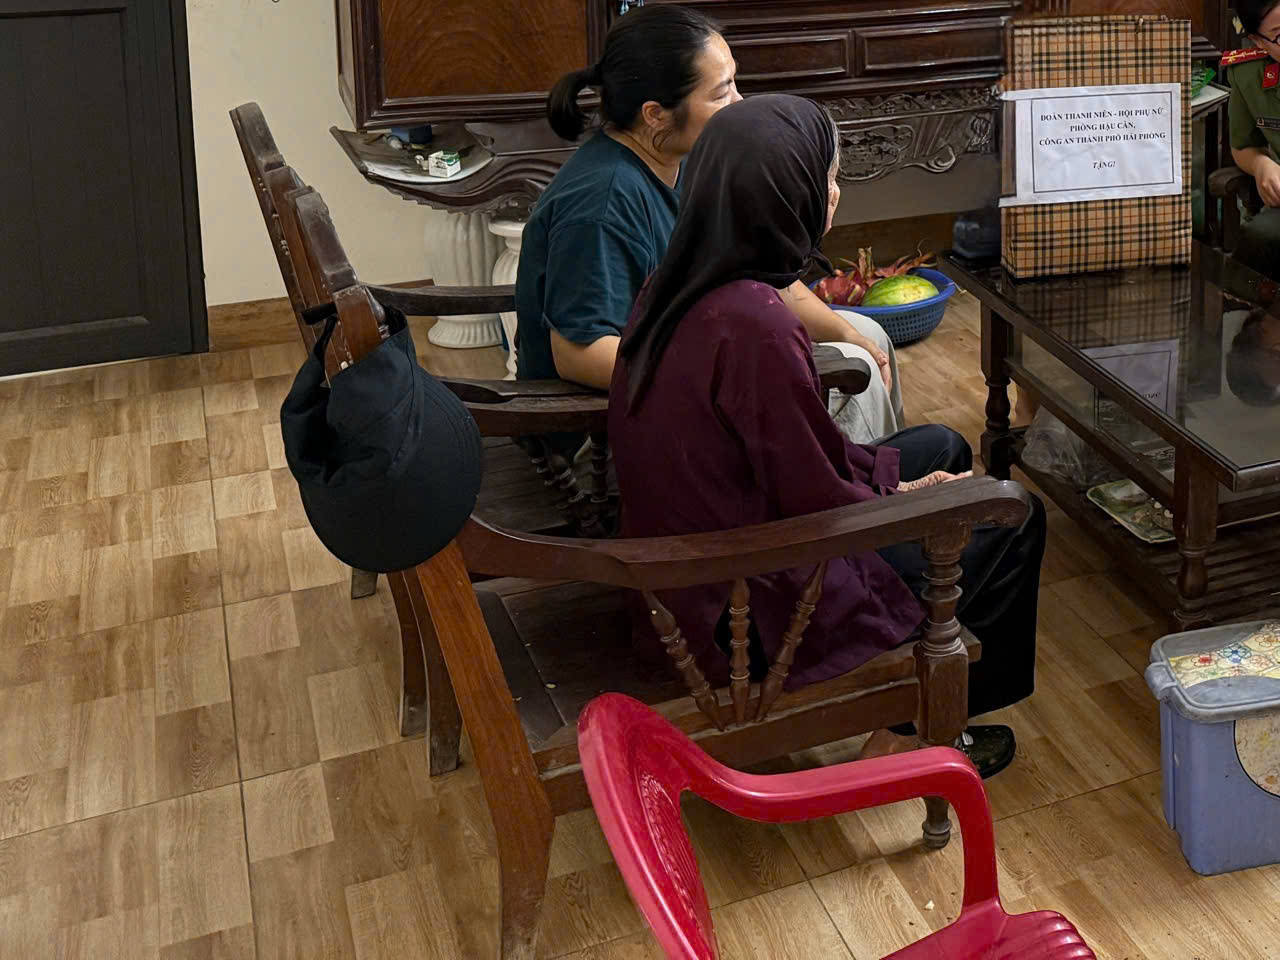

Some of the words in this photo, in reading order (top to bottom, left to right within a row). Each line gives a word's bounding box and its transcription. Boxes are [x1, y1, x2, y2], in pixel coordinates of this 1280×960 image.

[1040, 112, 1063, 121] ĐOÀN
[1064, 111, 1092, 120] THANH
[1094, 109, 1112, 118] NIÊN
[1135, 109, 1150, 117] PHỤ
[1070, 123, 1097, 132] PHÒNG
[1039, 137, 1062, 146] CÔNG
[1063, 137, 1074, 145] AN
[1076, 135, 1103, 143] THÀNH
[1139, 132, 1166, 140] PHÒNG
